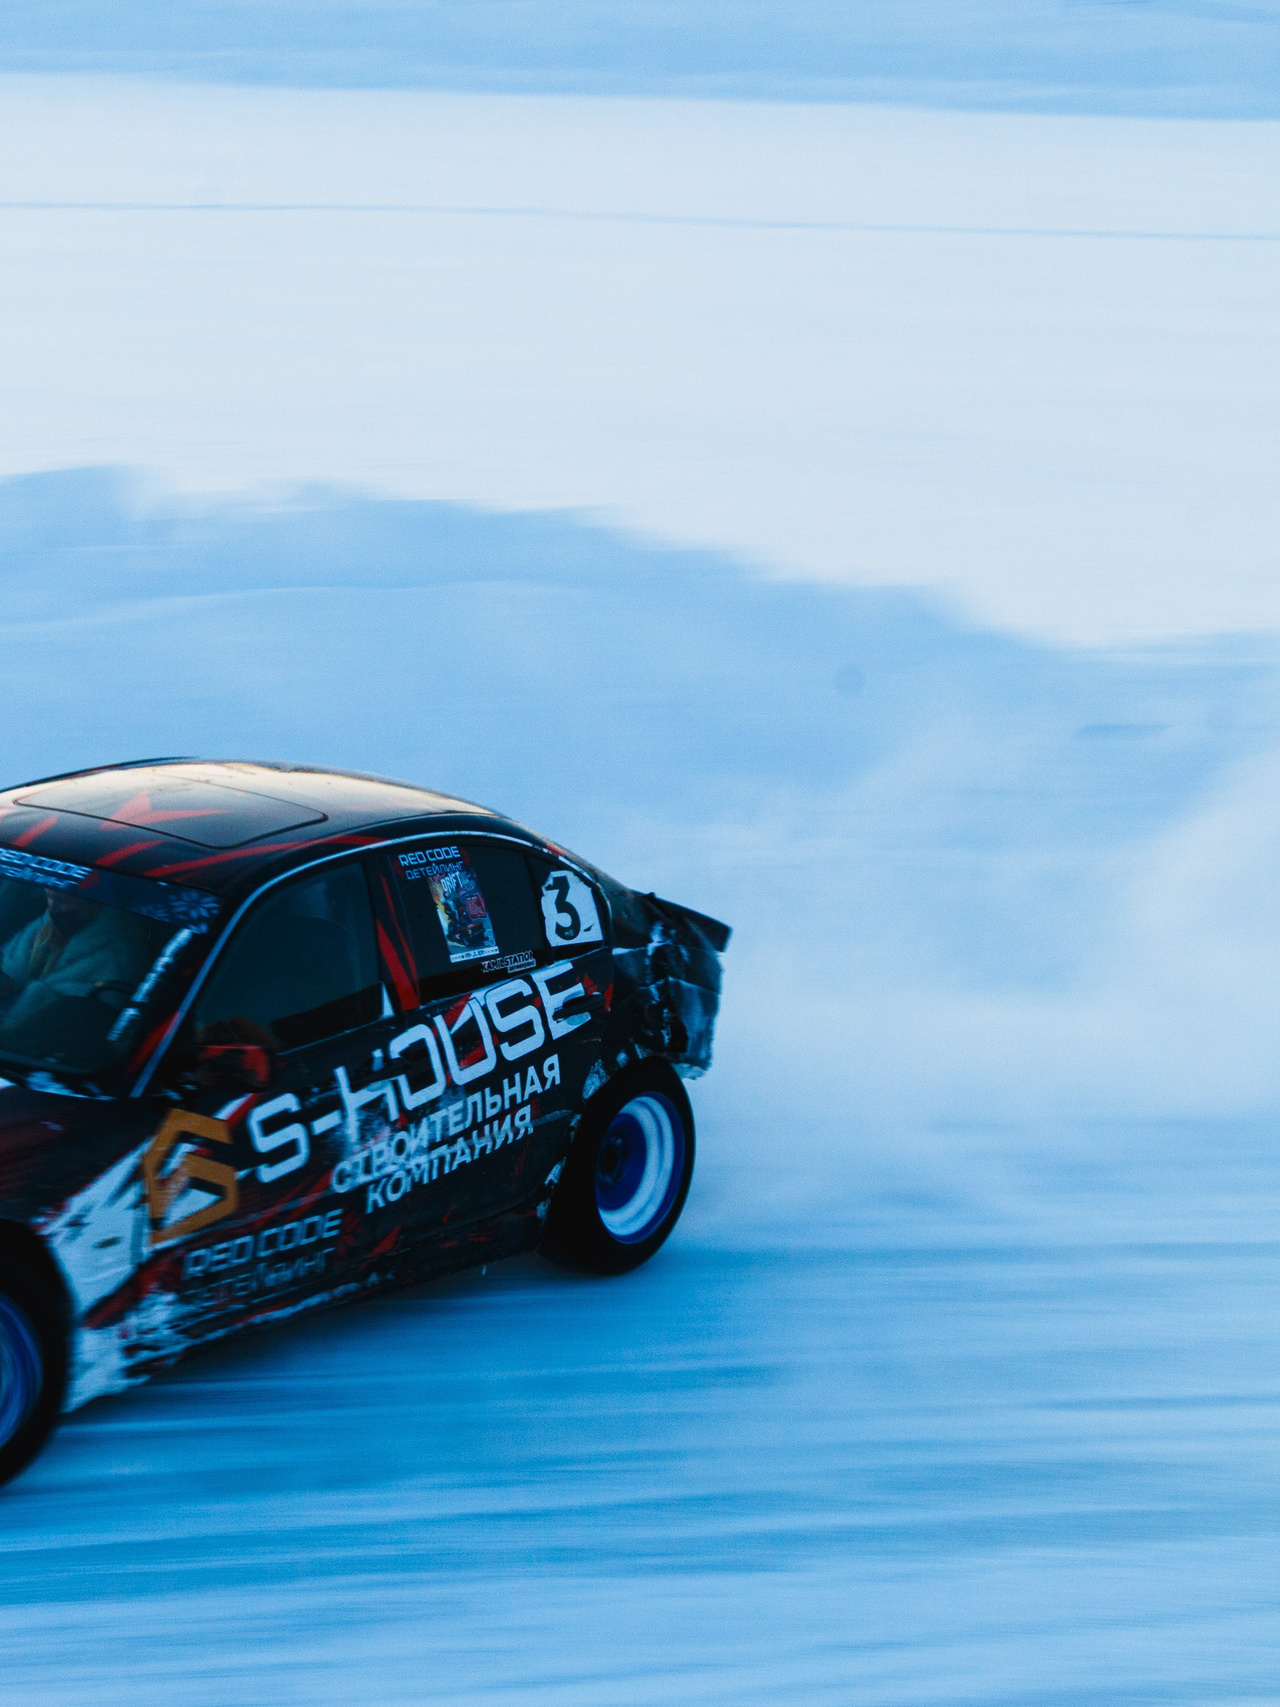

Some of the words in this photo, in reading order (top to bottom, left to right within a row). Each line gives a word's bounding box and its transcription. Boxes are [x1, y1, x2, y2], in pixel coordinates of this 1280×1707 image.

[398, 851, 426, 867] RED
[426, 846, 461, 861] CODE
[440, 871, 463, 893] DRIFT
[545, 876, 581, 940] 3
[247, 962, 591, 1183] S-HOUSE
[365, 1105, 534, 1214] КОМПАНИЯ
[257, 1208, 344, 1258] CODE
